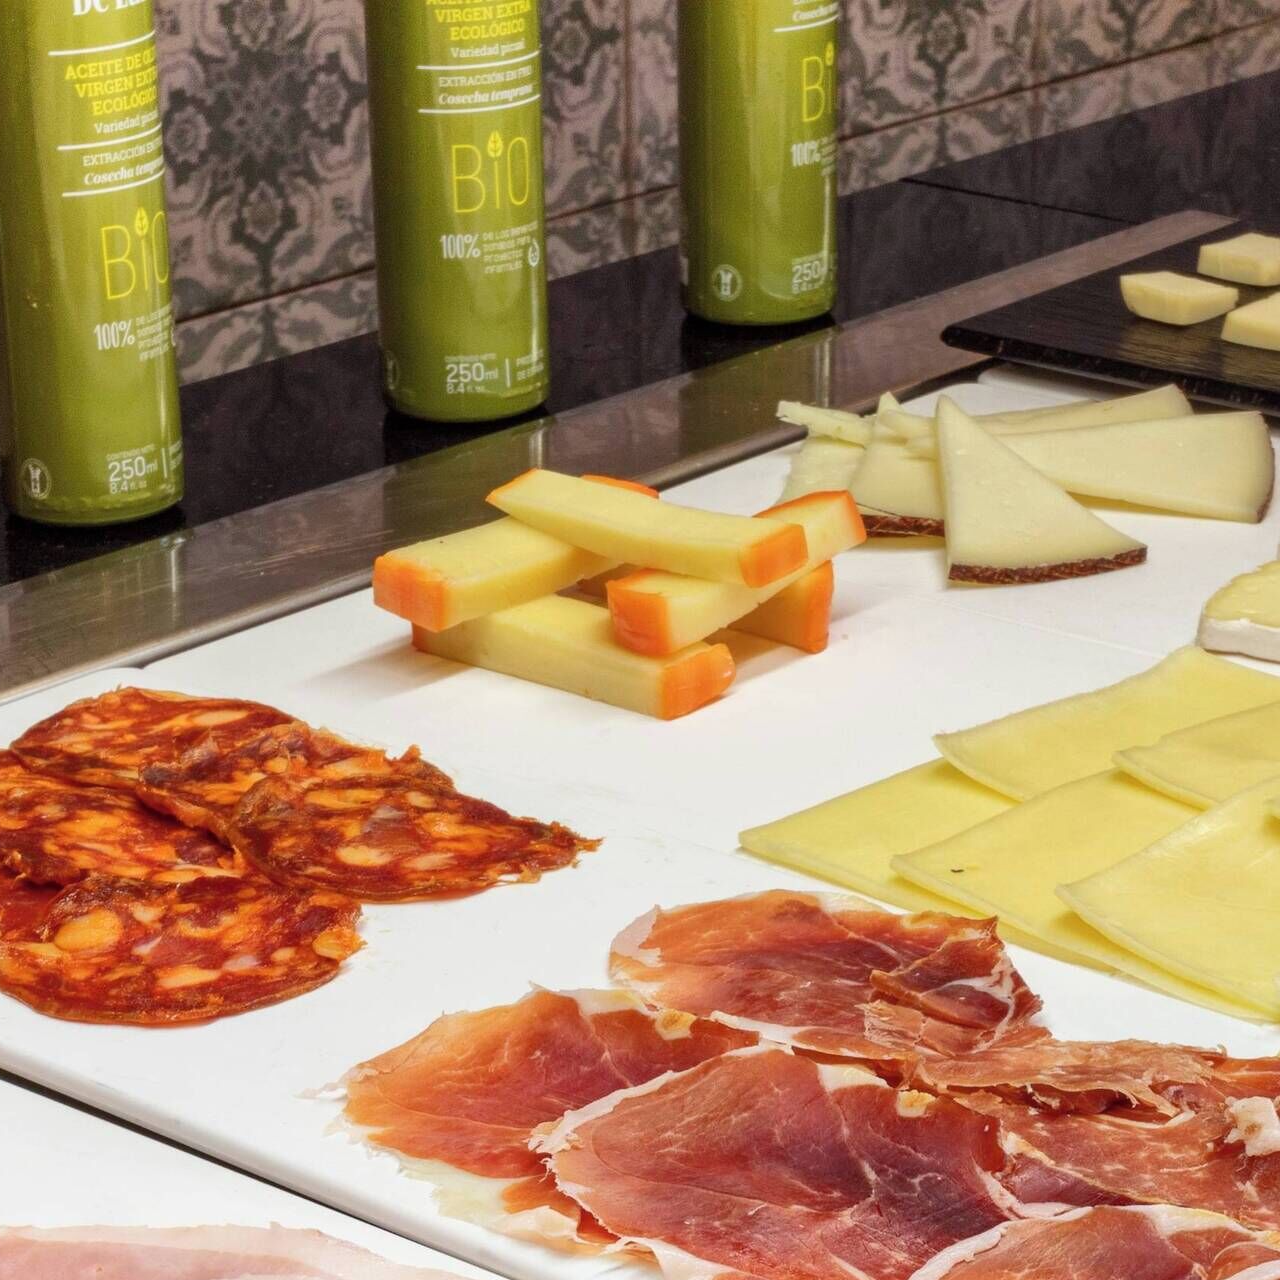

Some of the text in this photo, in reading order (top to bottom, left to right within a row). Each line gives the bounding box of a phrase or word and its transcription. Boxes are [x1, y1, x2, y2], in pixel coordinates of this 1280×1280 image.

[435, 6, 494, 23] VIRGEN
[450, 17, 525, 40] ECOLÓGICO
[450, 43, 499, 58] Variedad
[65, 58, 123, 80] ACEITE
[126, 53, 142, 70] DE
[75, 75, 134, 98] VIRGEN
[439, 90, 489, 105] Cosecha
[440, 233, 480, 259] 100%
[94, 319, 135, 351] 100%
